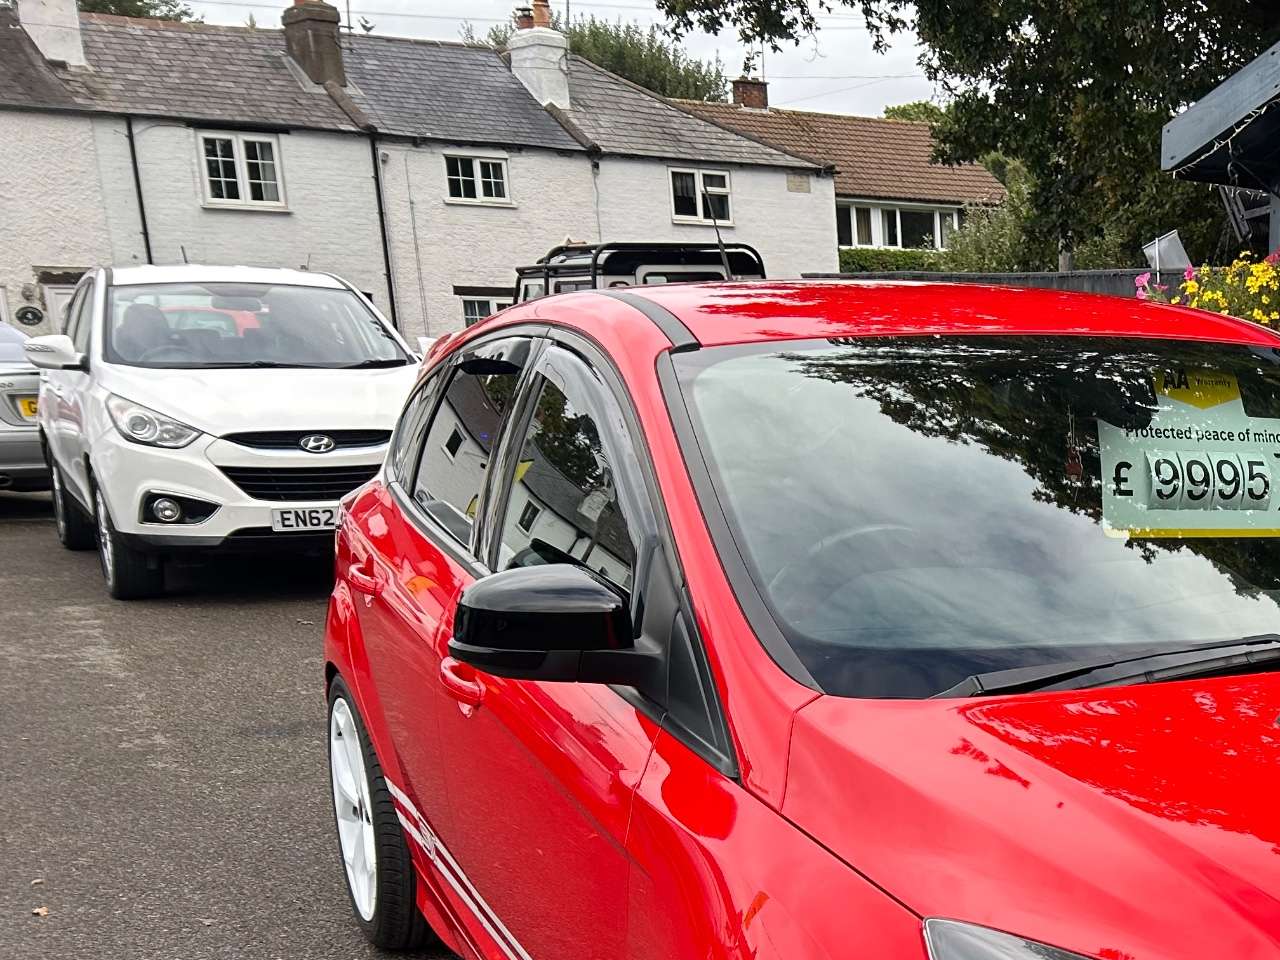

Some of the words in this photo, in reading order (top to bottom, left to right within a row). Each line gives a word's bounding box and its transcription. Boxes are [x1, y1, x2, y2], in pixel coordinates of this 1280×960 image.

[1126, 424, 1192, 440] Protected
[1196, 429, 1235, 443] peace
[1238, 428, 1251, 441] of
[1113, 461, 1133, 496] £
[1154, 458, 1269, 501] 9995
[280, 509, 335, 528] EN62
